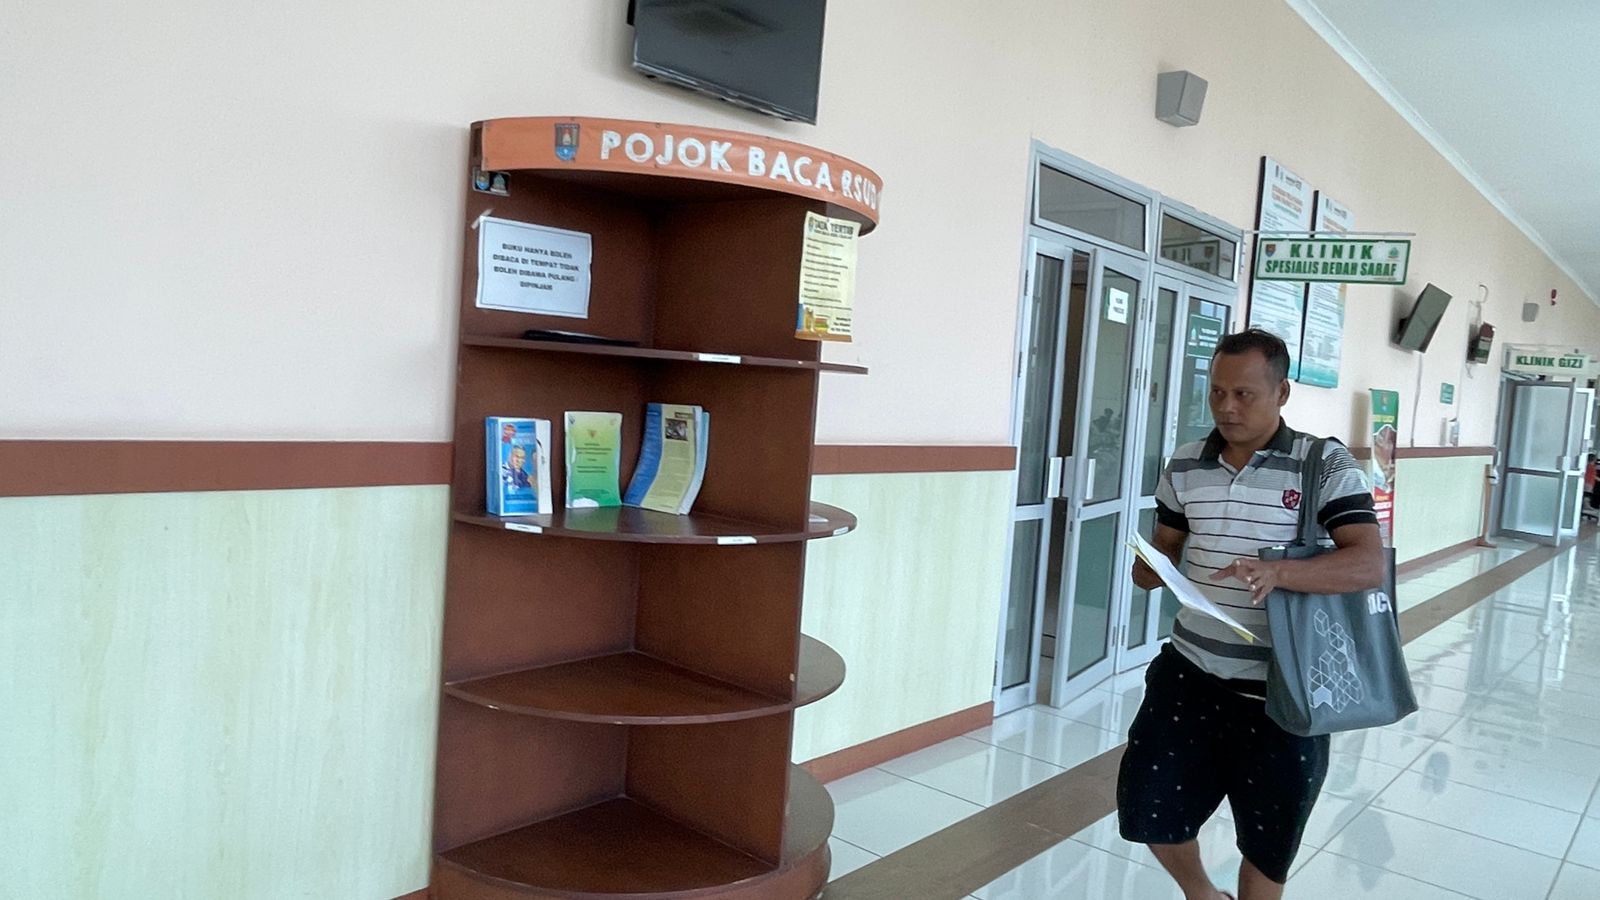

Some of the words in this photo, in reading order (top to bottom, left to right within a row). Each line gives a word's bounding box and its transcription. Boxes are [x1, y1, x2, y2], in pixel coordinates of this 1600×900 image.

[600, 130, 733, 173] POJOK
[748, 146, 835, 193] BACA
[1290, 243, 1374, 260] KLINIK
[1265, 260, 1319, 275] SPESIALIS
[1321, 261, 1358, 276] BEDAH
[1360, 262, 1397, 277] SARAF
[1516, 355, 1555, 367] KLINIK
[1558, 357, 1583, 369] GIZI
